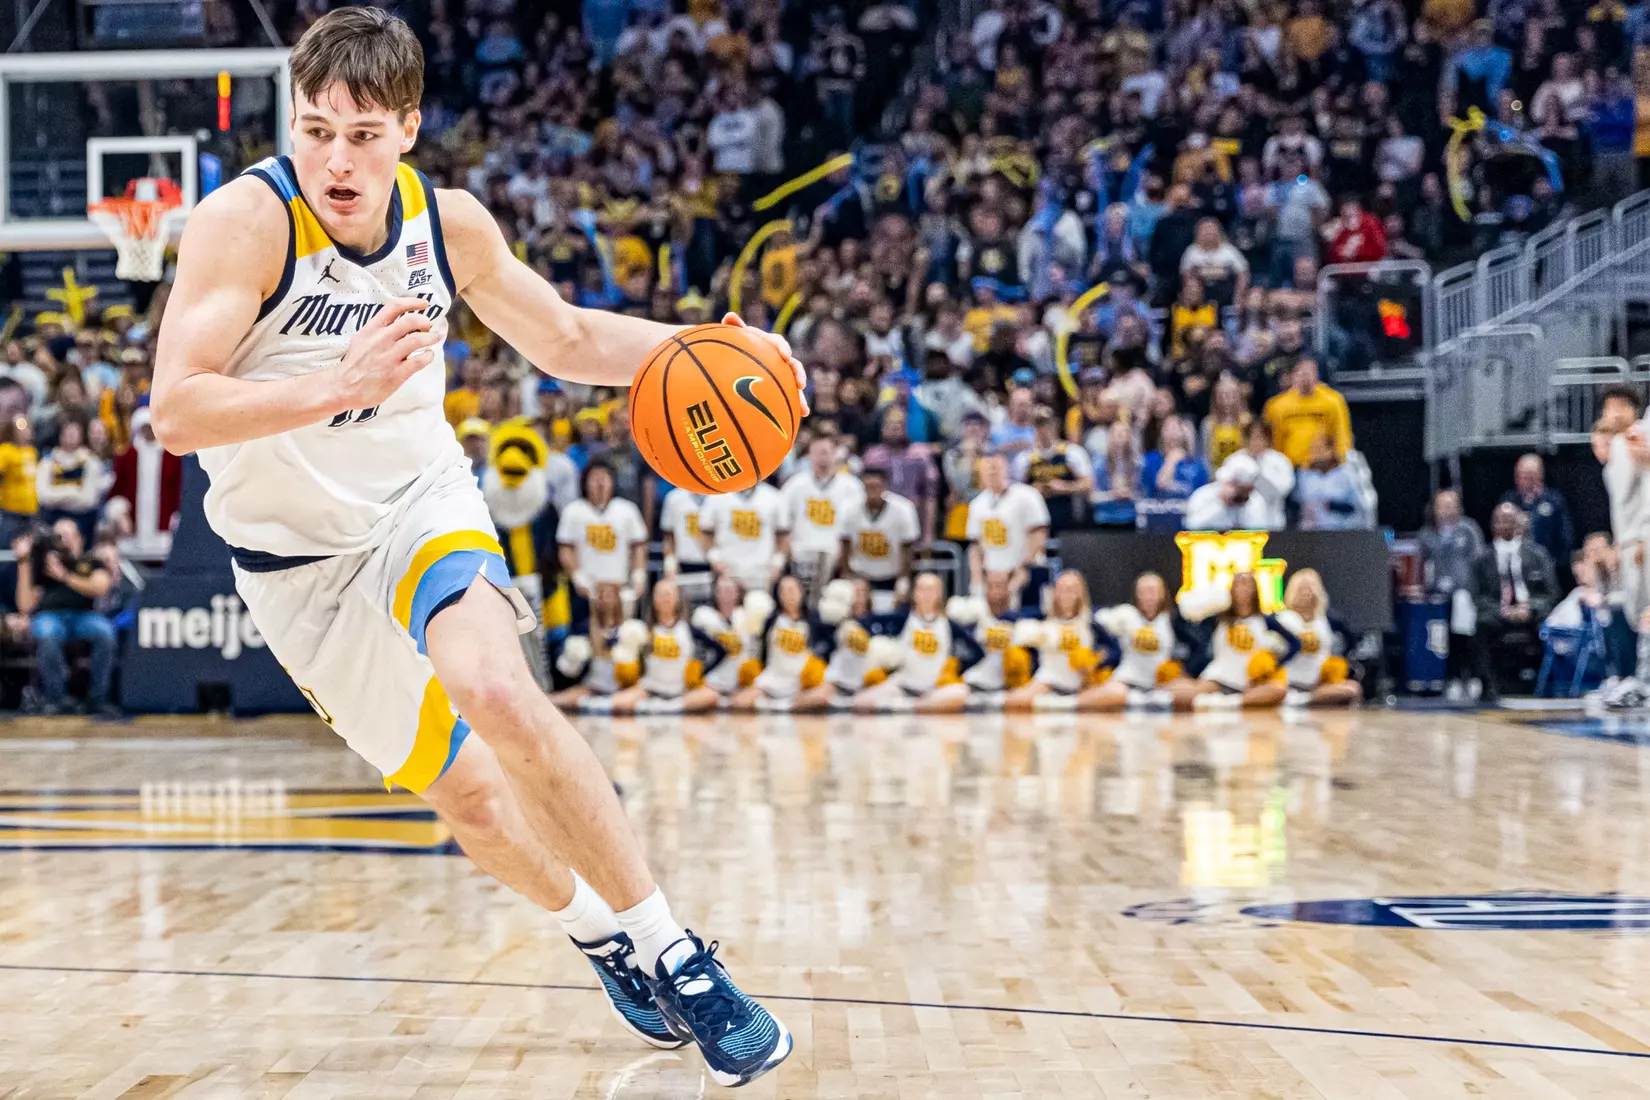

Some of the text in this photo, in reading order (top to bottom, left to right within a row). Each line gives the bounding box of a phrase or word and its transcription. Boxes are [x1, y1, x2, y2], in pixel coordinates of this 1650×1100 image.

[408, 274, 433, 286] EAST
[410, 268, 427, 279] BIG
[681, 413, 721, 483] AMPIONSHIP
[686, 399, 744, 481] ELITE
[138, 594, 268, 660] meije
